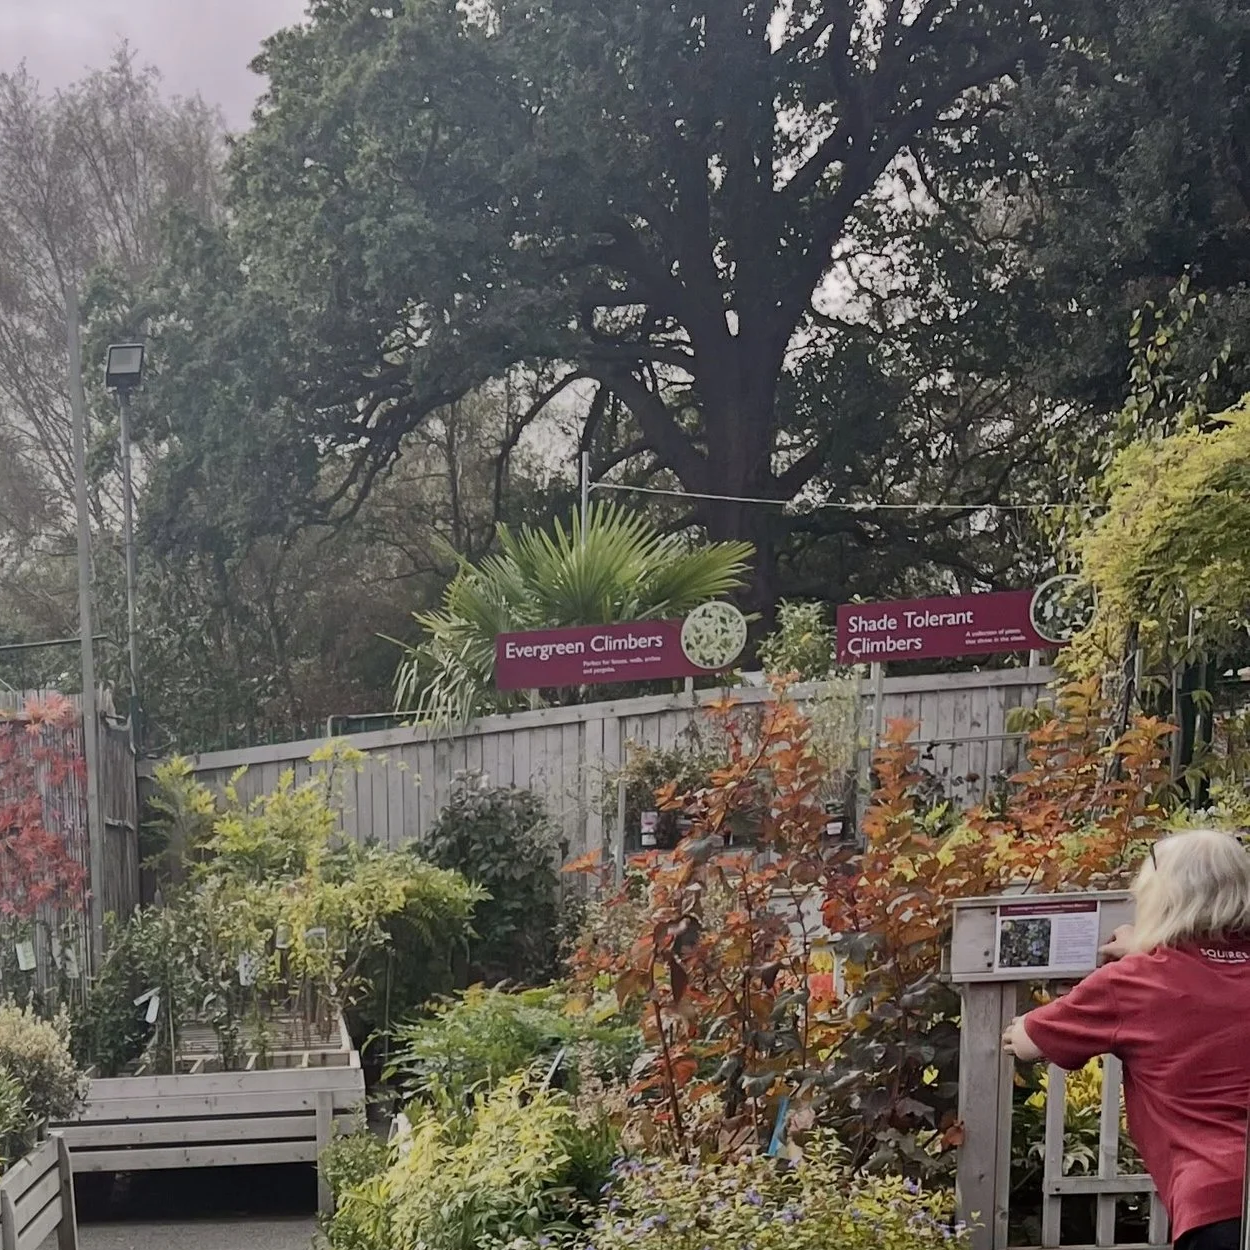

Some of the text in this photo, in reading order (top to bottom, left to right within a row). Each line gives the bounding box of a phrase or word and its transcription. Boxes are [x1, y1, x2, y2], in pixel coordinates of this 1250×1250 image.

[848, 610, 974, 633] Shade Tolerant
[505, 633, 663, 661] Evergreen Climbers
[847, 635, 923, 656] Climbers
